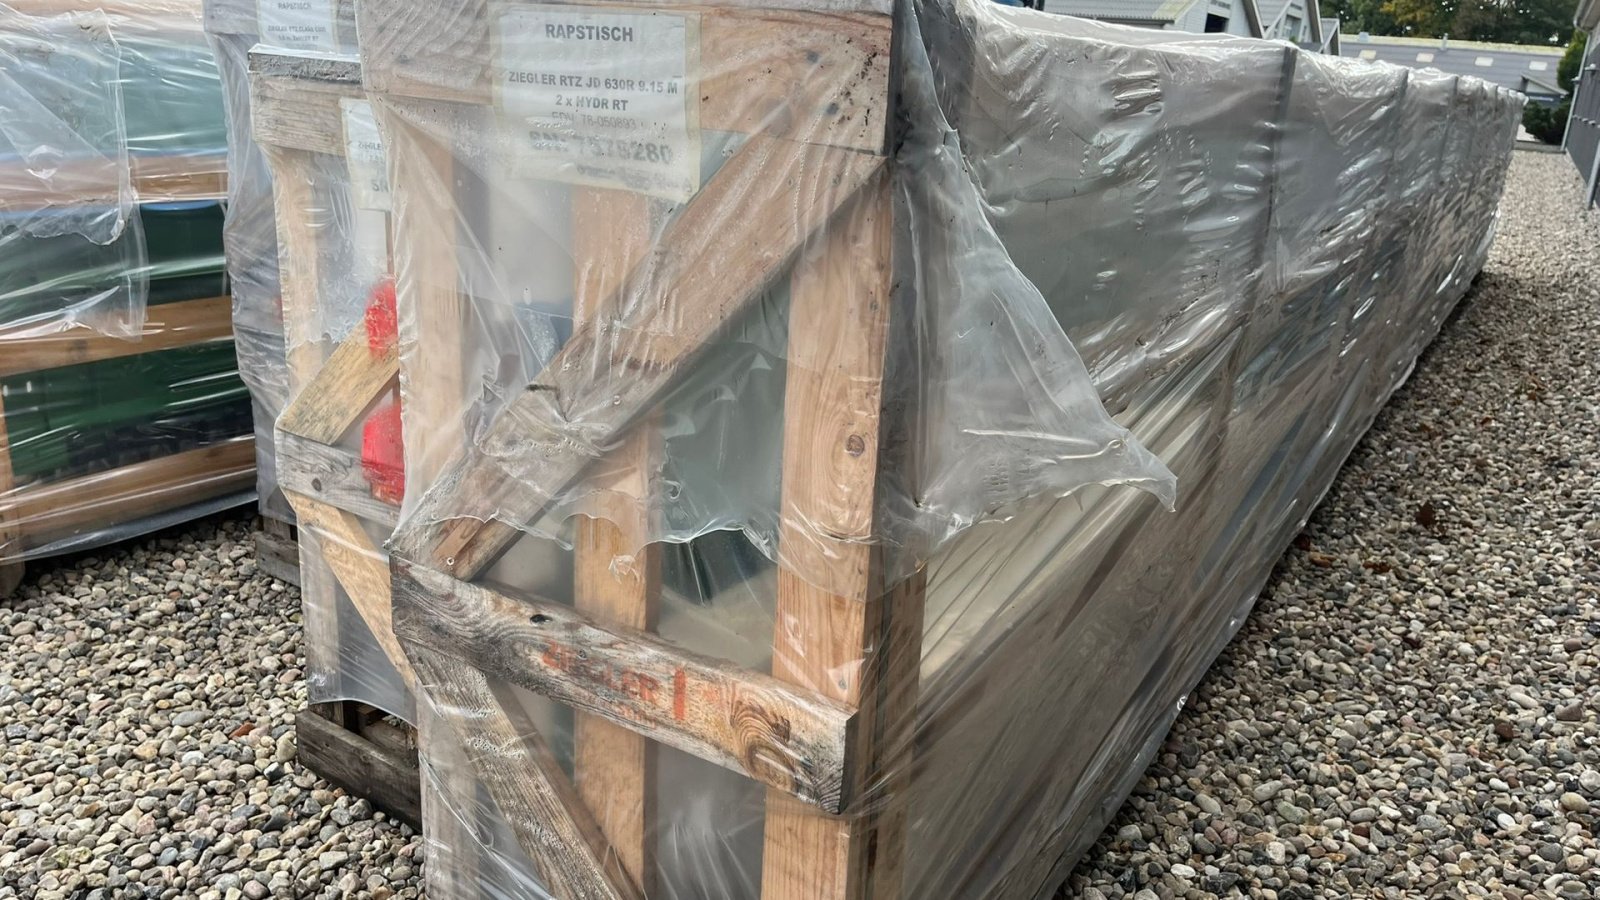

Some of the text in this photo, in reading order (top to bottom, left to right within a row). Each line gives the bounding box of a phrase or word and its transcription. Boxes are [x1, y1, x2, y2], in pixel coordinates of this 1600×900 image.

[545, 24, 633, 42] RAPSTISCH
[508, 71, 678, 94] ZIEGLER RTZ JD 630R 9.15 M
[555, 94, 629, 112] 2 x HYDR RT
